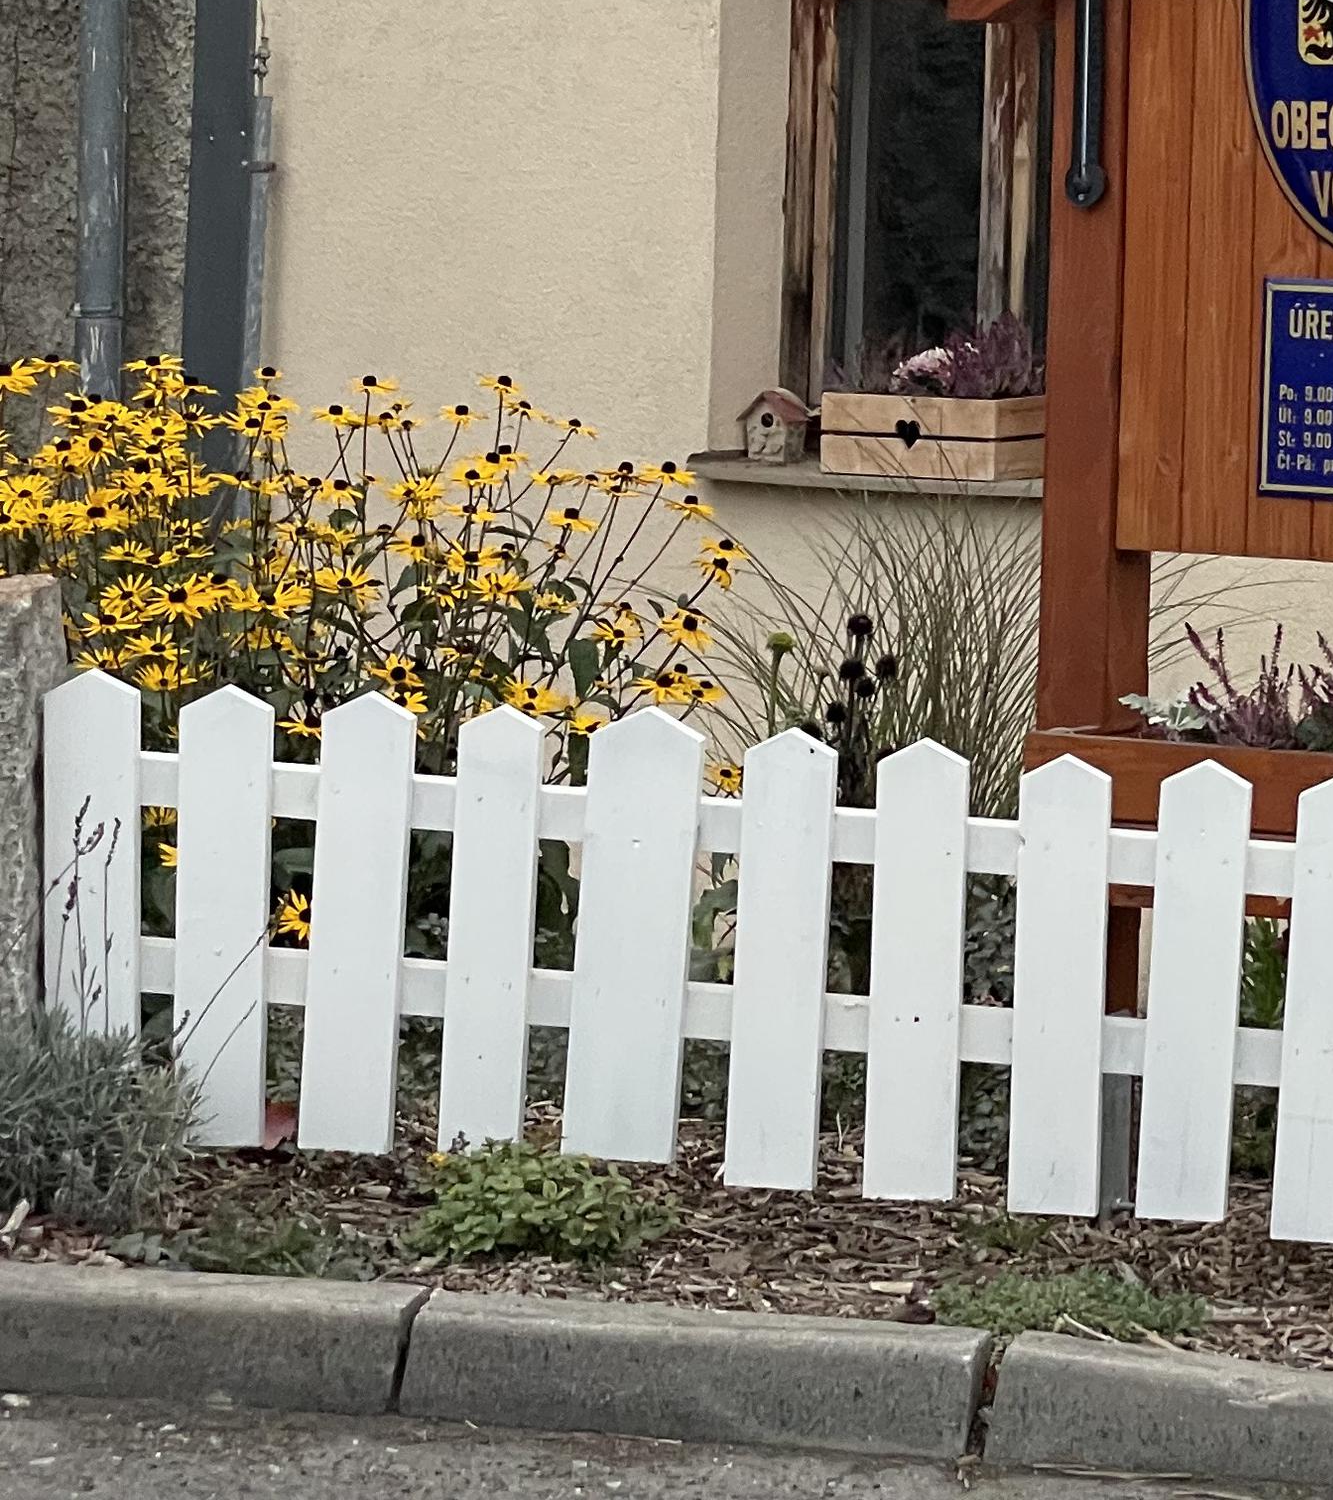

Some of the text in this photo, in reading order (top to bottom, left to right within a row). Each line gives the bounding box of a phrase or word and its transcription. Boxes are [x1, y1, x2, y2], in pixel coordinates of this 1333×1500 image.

[1304, 386, 1333, 403] 9.00
[1304, 408, 1333, 426] 9.00
[1303, 432, 1332, 449] 9.00
